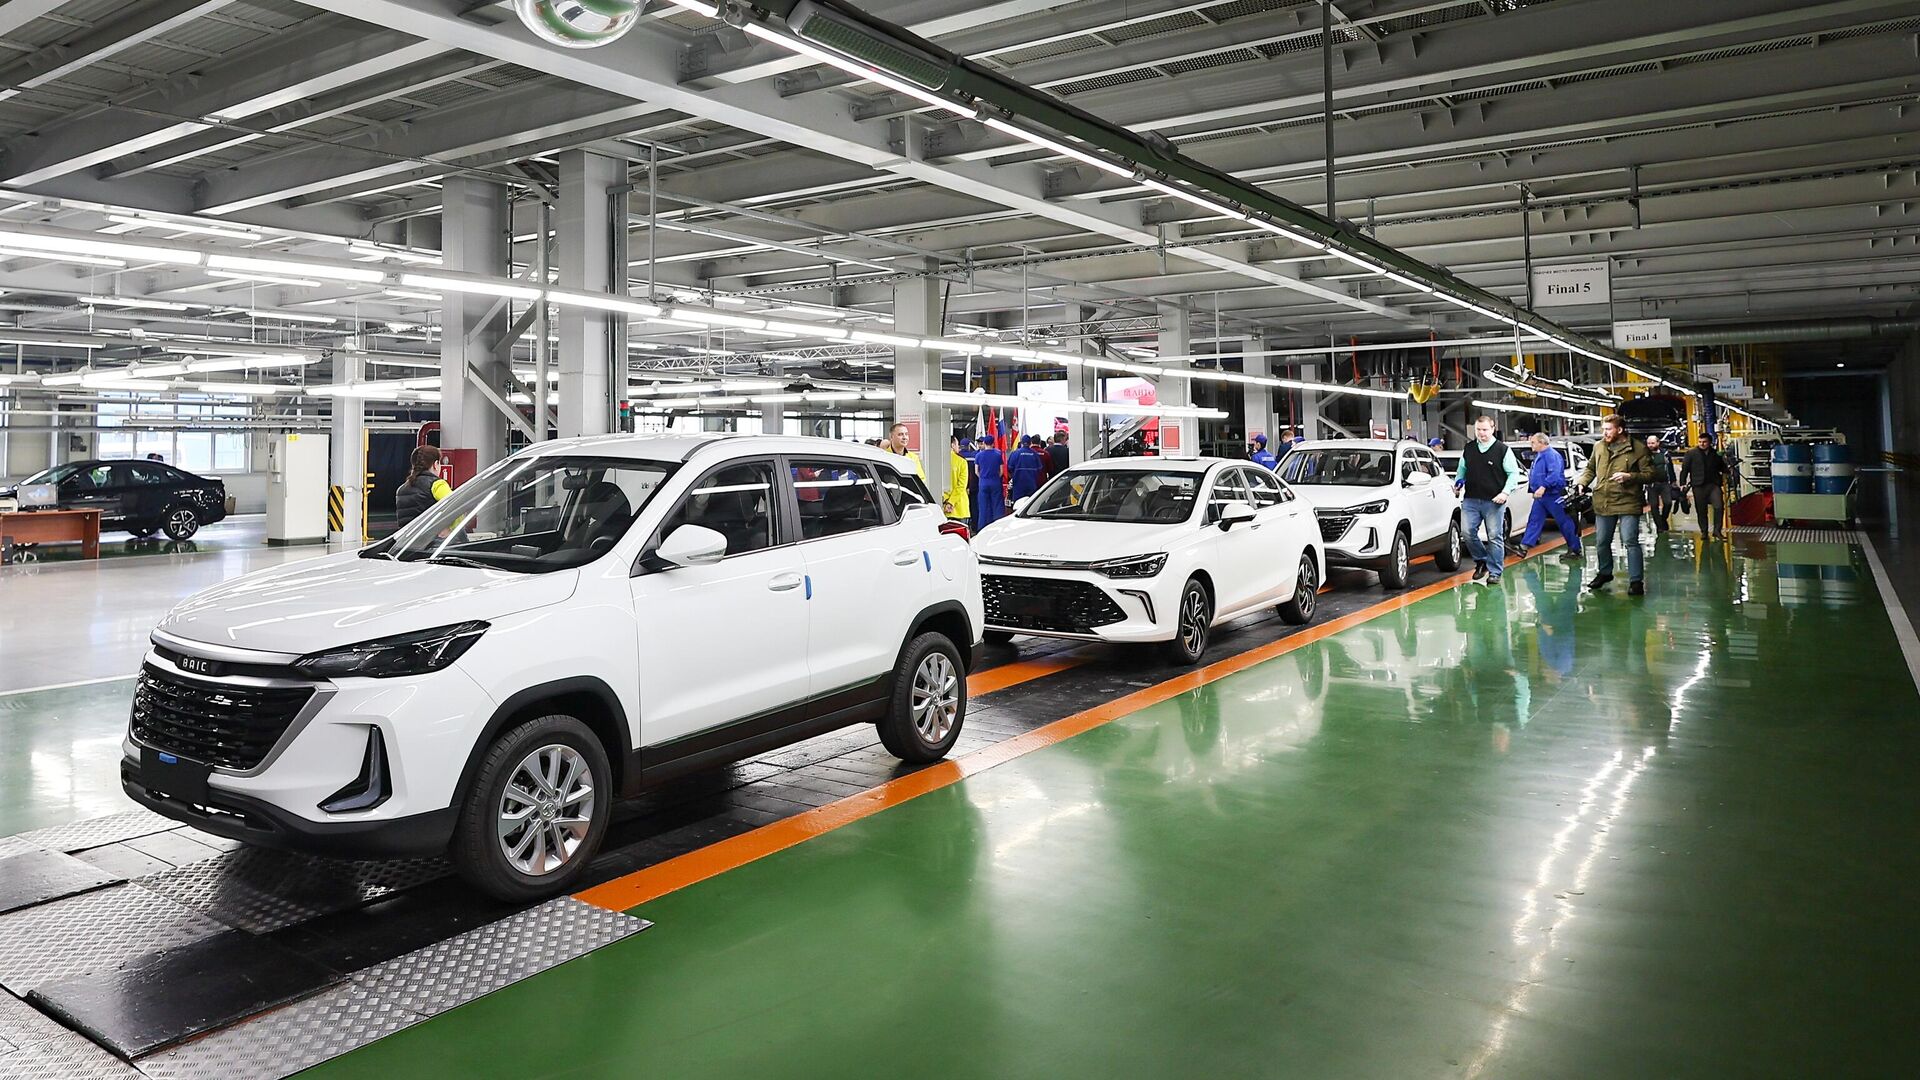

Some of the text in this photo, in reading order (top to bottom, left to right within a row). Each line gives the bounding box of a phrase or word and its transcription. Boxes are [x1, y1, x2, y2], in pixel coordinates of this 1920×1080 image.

[1547, 282, 1591, 294] Final 5
[1626, 333, 1650, 342] Final
[183, 658, 207, 671] BAIC
